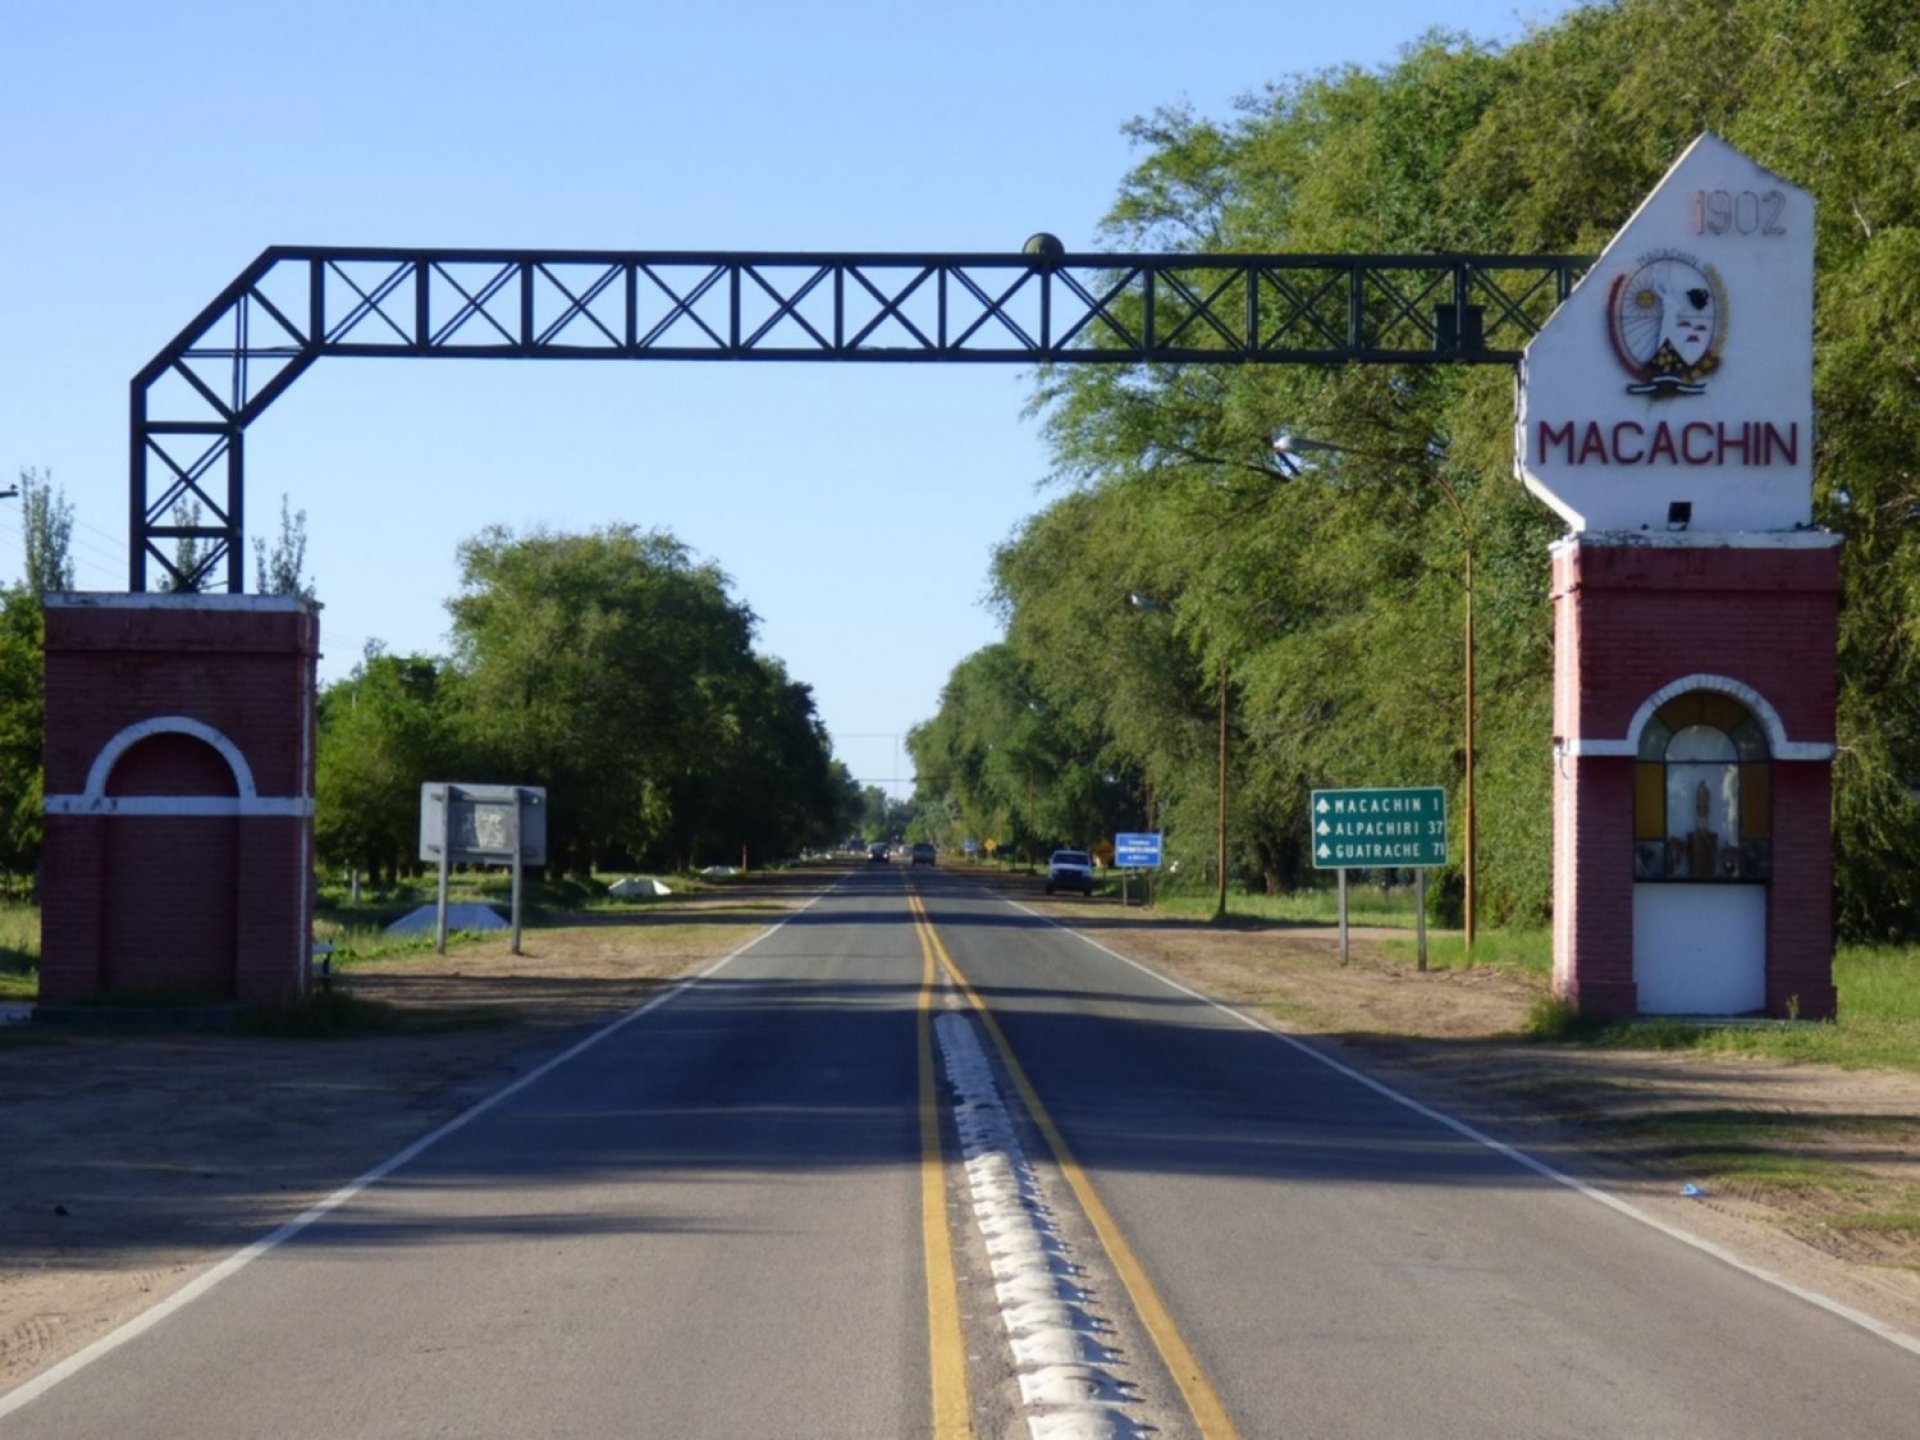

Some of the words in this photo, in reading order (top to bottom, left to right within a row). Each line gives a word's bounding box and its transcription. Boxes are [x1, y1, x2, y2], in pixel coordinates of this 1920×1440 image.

[1692, 188, 1788, 236] 1902
[1538, 420, 1798, 466] MACACHIN
[1334, 798, 1421, 812] MACACHIN
[1432, 797, 1439, 811] 1
[1335, 821, 1419, 836] ALPACHIRI
[1428, 820, 1444, 835] 37
[1335, 843, 1420, 859] GUATRACHE
